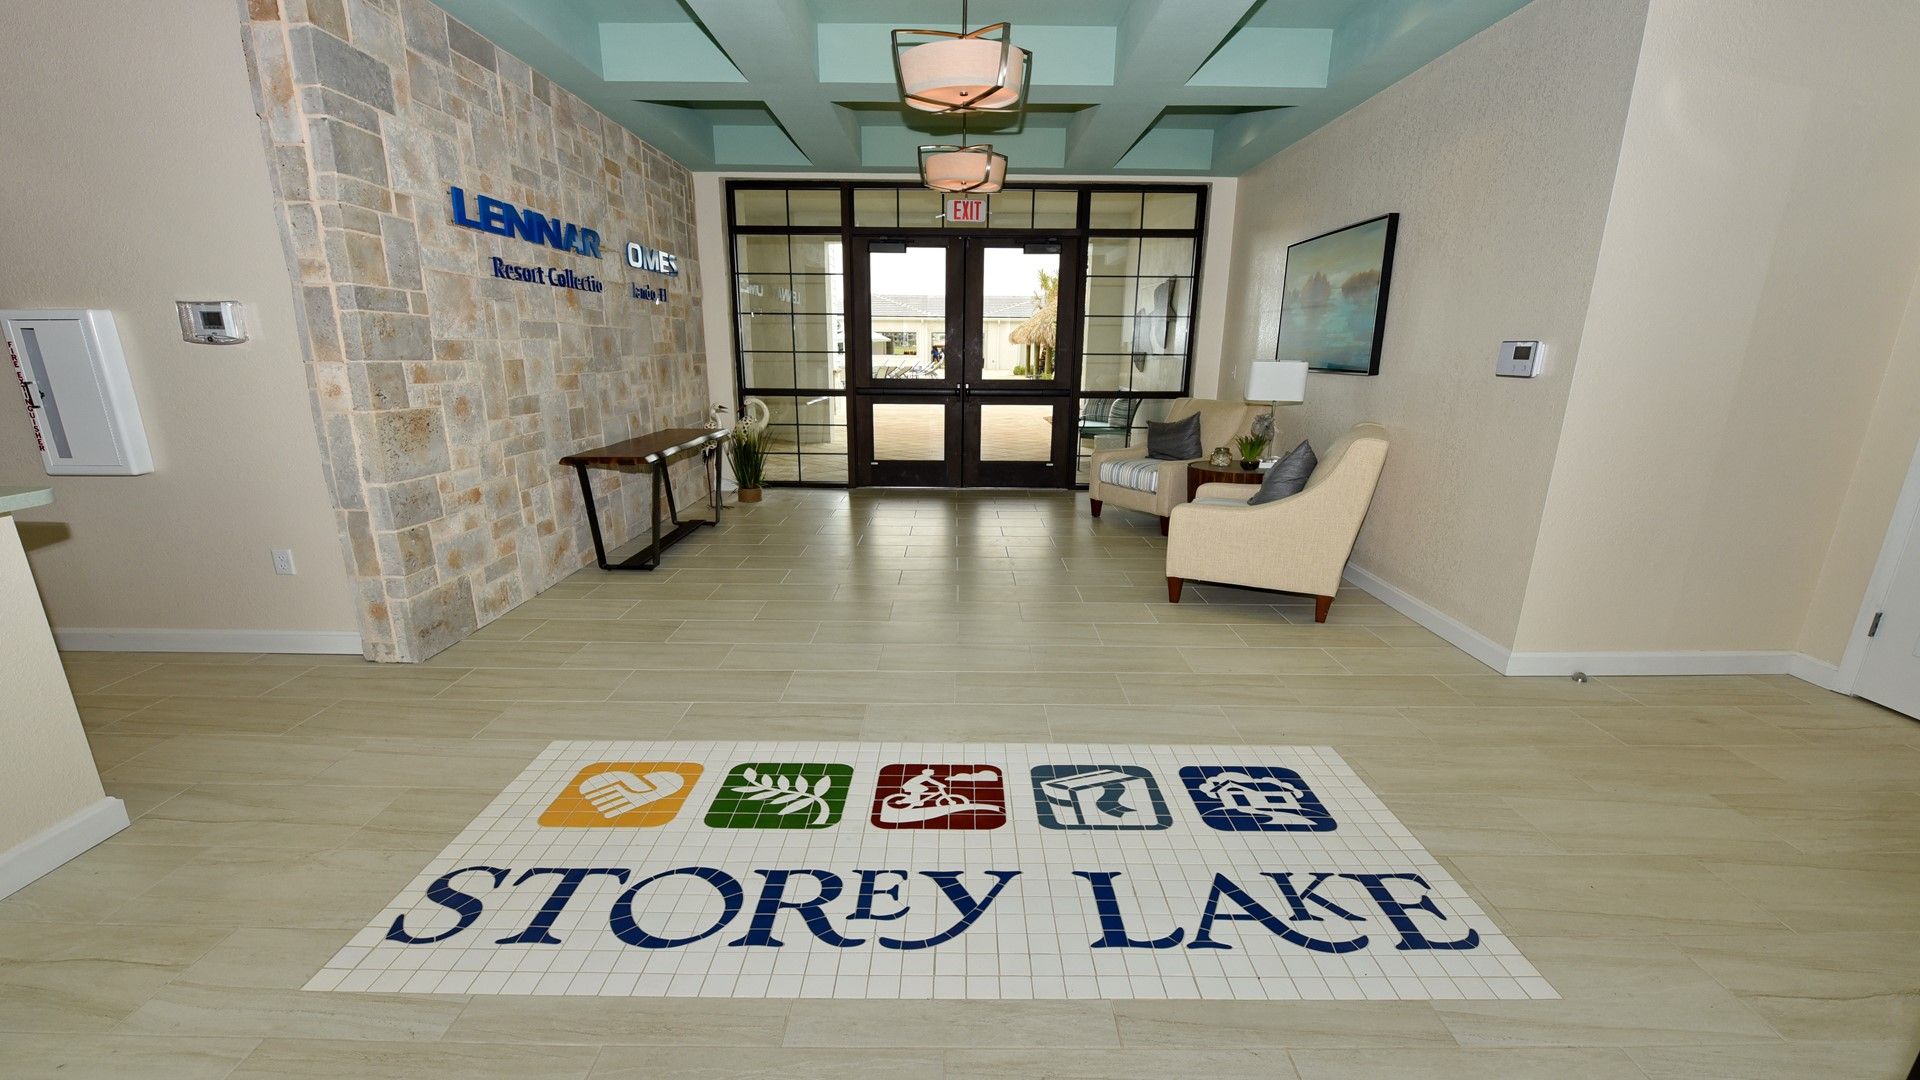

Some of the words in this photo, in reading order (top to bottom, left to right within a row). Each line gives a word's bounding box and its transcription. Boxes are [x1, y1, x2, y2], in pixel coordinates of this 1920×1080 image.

[451, 186, 603, 259] LENNAR
[953, 200, 982, 220] EXIT
[492, 256, 546, 285] Resort
[7, 341, 19, 368] FIRE
[16, 371, 45, 451] EXTINGUISHER
[385, 866, 1022, 950] STOREY
[1072, 871, 1480, 954] LAKE
